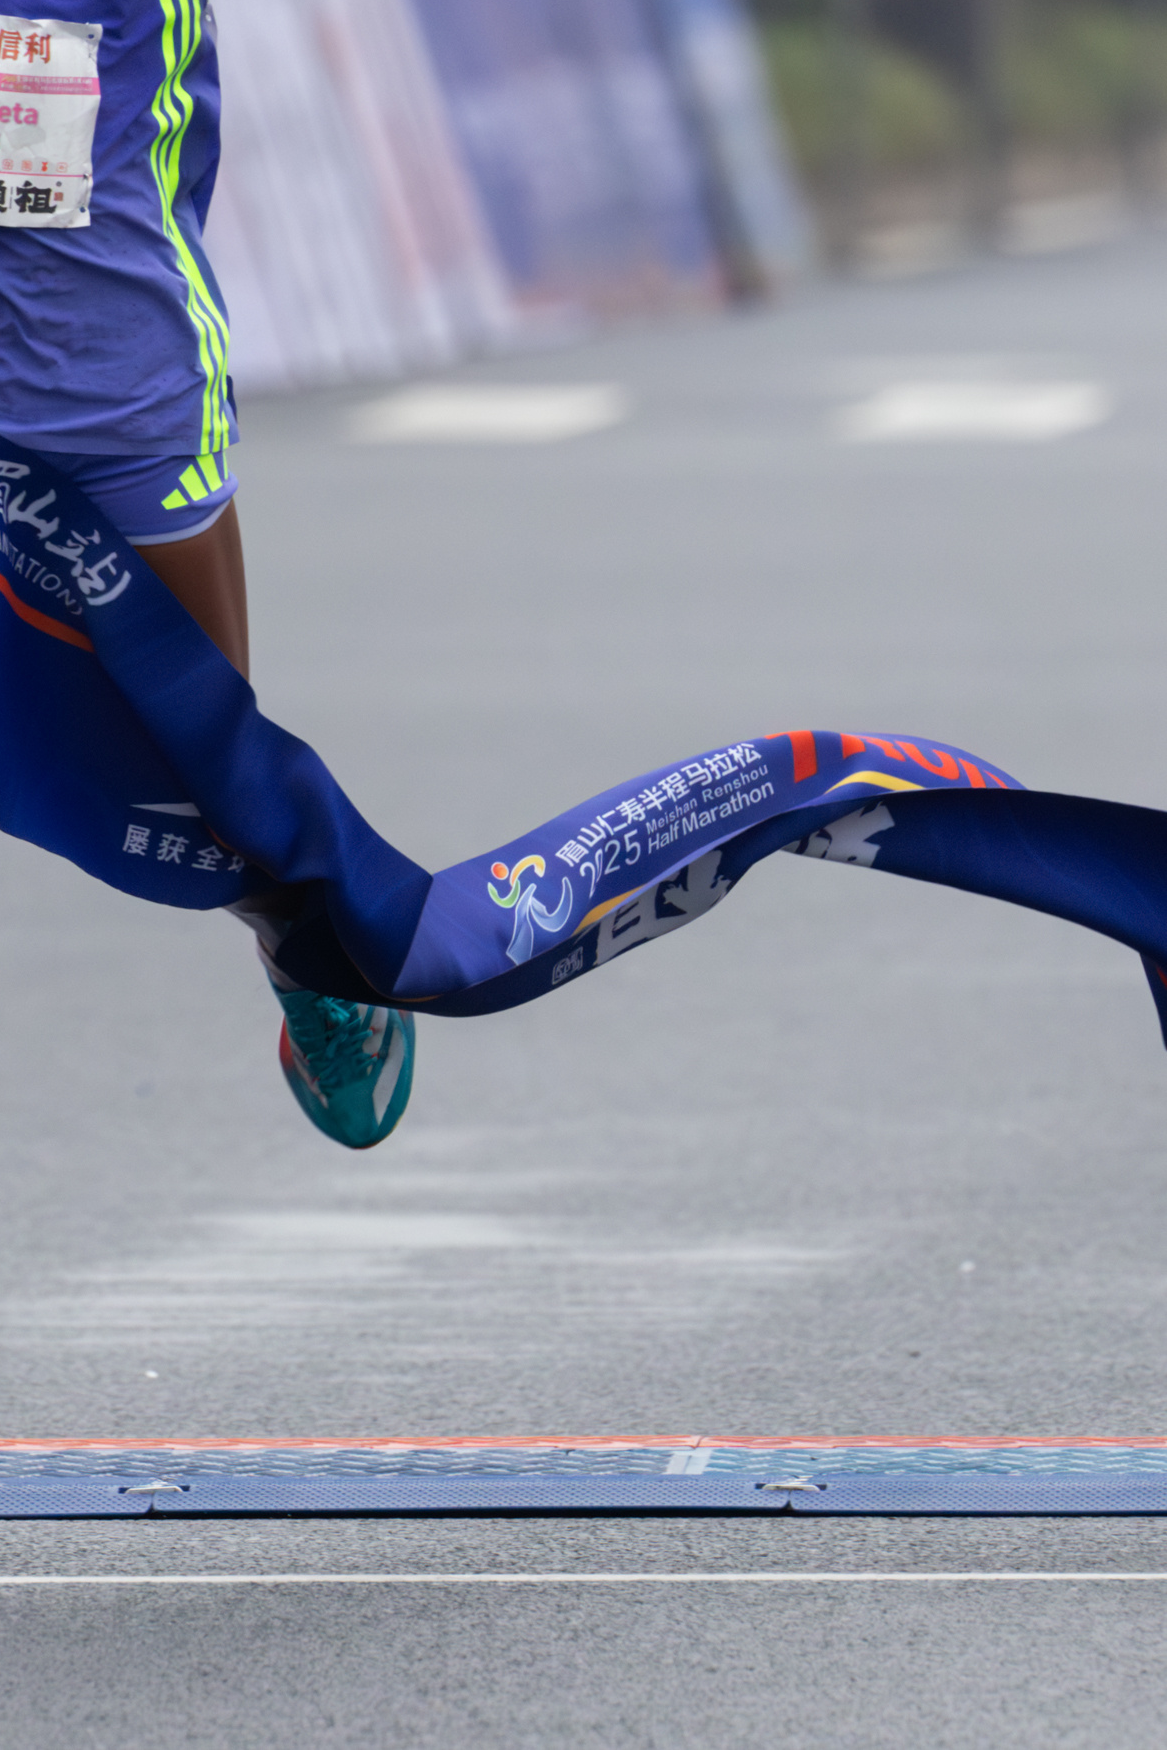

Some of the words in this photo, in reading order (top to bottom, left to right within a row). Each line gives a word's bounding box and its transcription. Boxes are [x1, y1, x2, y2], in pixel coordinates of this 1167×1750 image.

[7, 540, 83, 616] TATION)
[554, 742, 762, 868] 眉山仁寿半程马拉松
[645, 797, 698, 836] Meishan
[701, 763, 770, 804] Renshou
[647, 824, 681, 855] Half
[682, 781, 776, 837] Marathon
